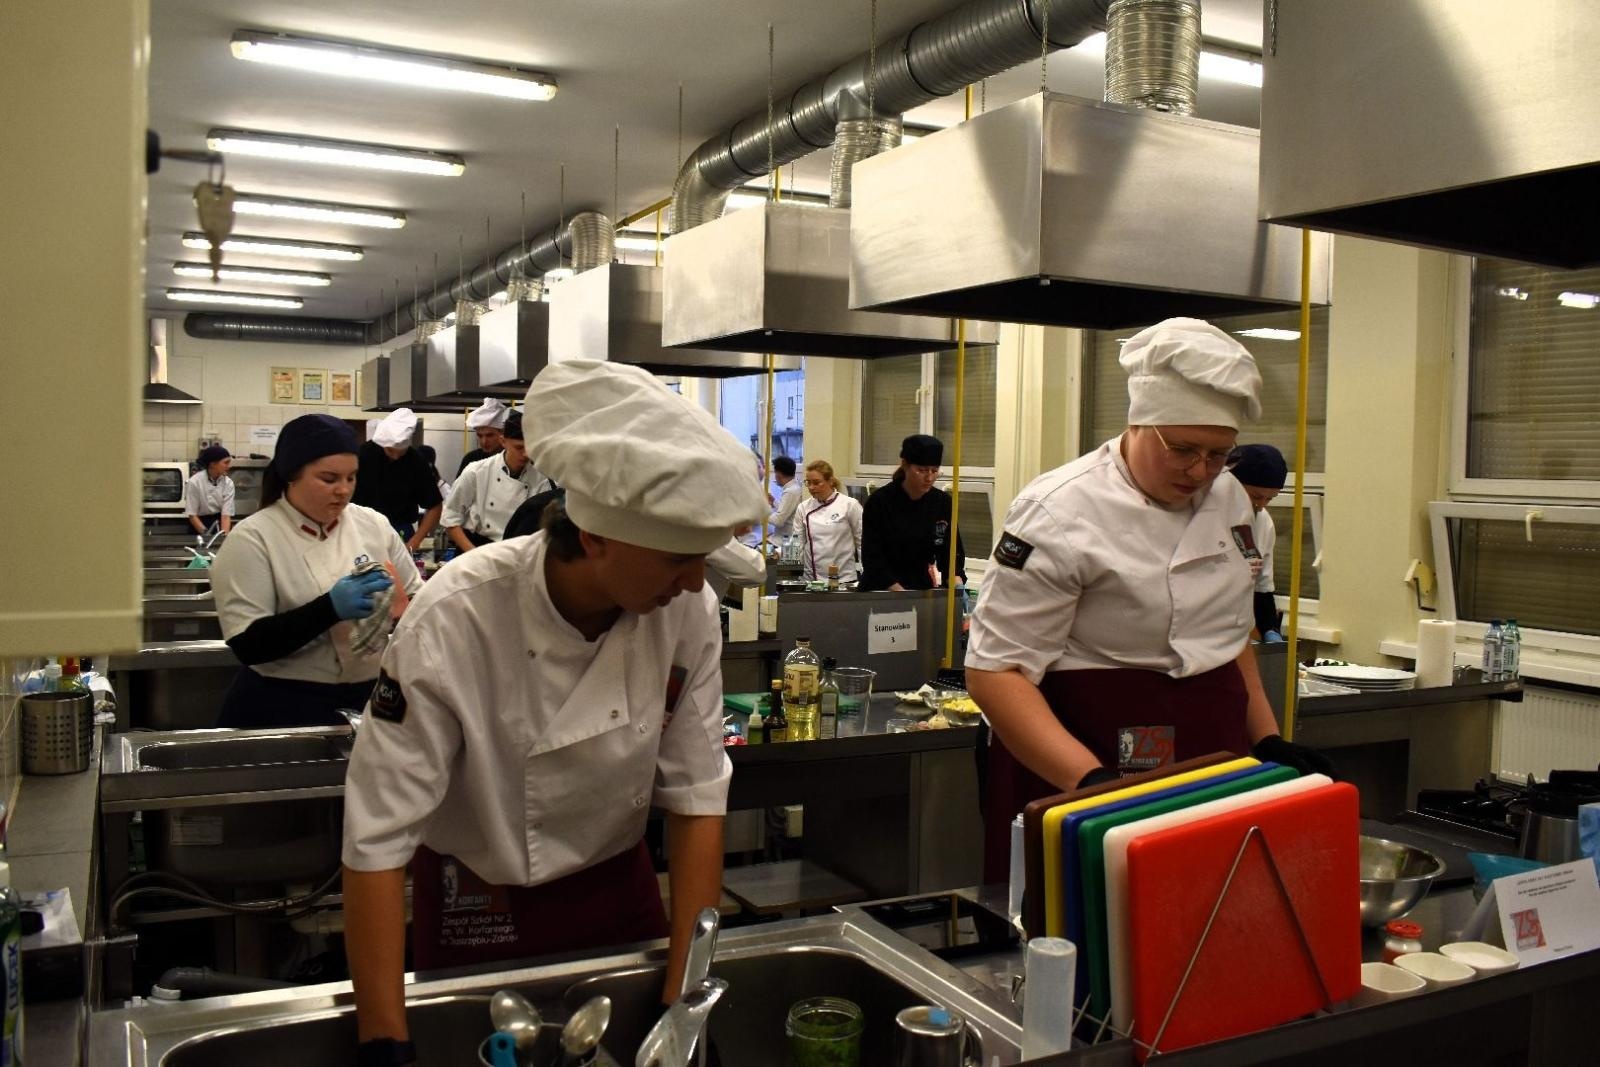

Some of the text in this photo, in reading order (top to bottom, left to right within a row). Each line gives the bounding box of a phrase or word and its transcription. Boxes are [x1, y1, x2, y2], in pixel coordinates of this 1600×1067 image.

[874, 622, 911, 633] Stanowisko
[891, 636, 896, 644] 3
[507, 913, 512, 922] 2
